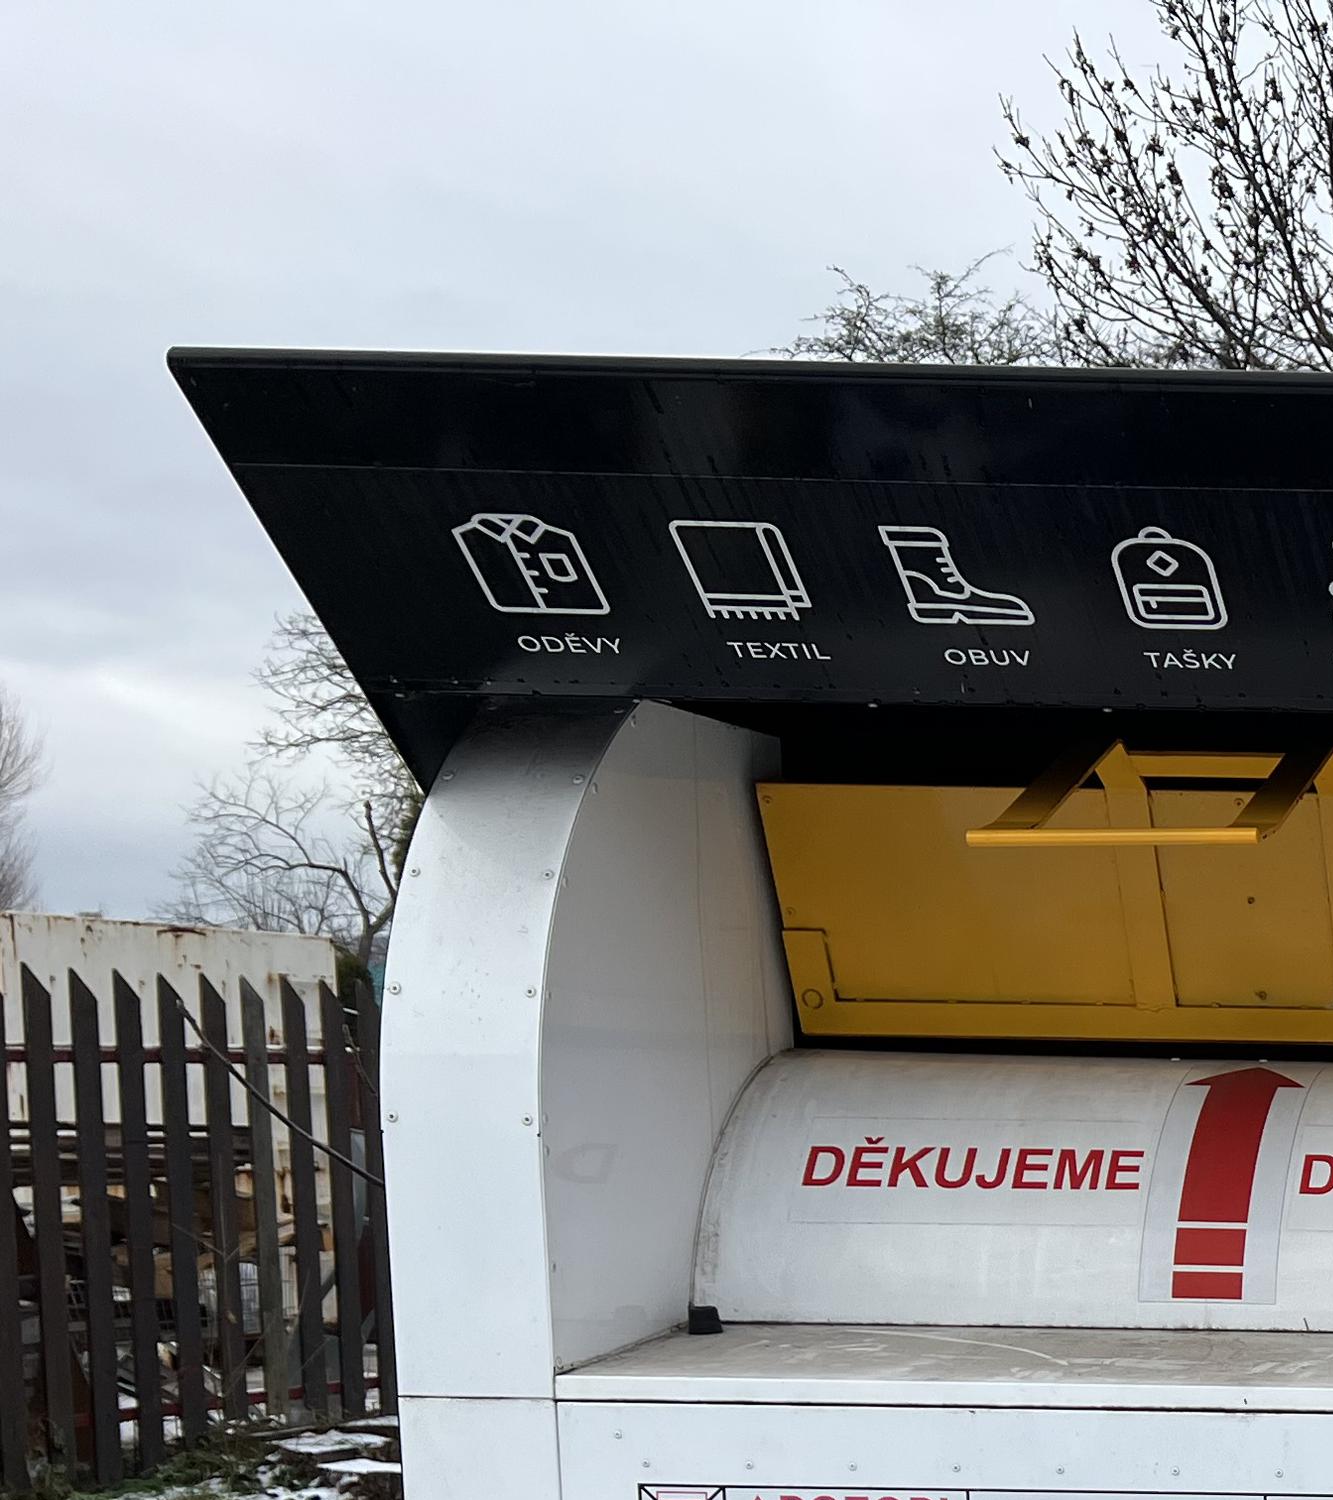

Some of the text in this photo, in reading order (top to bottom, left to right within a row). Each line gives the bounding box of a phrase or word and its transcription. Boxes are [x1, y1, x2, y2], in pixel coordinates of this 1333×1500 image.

[518, 633, 619, 653] ODĚVY
[727, 642, 831, 659] TEXTIL
[945, 649, 1029, 665] OBUV
[1144, 649, 1236, 669] TAŠKY
[802, 1137, 1144, 1190] DĚKUJEME
